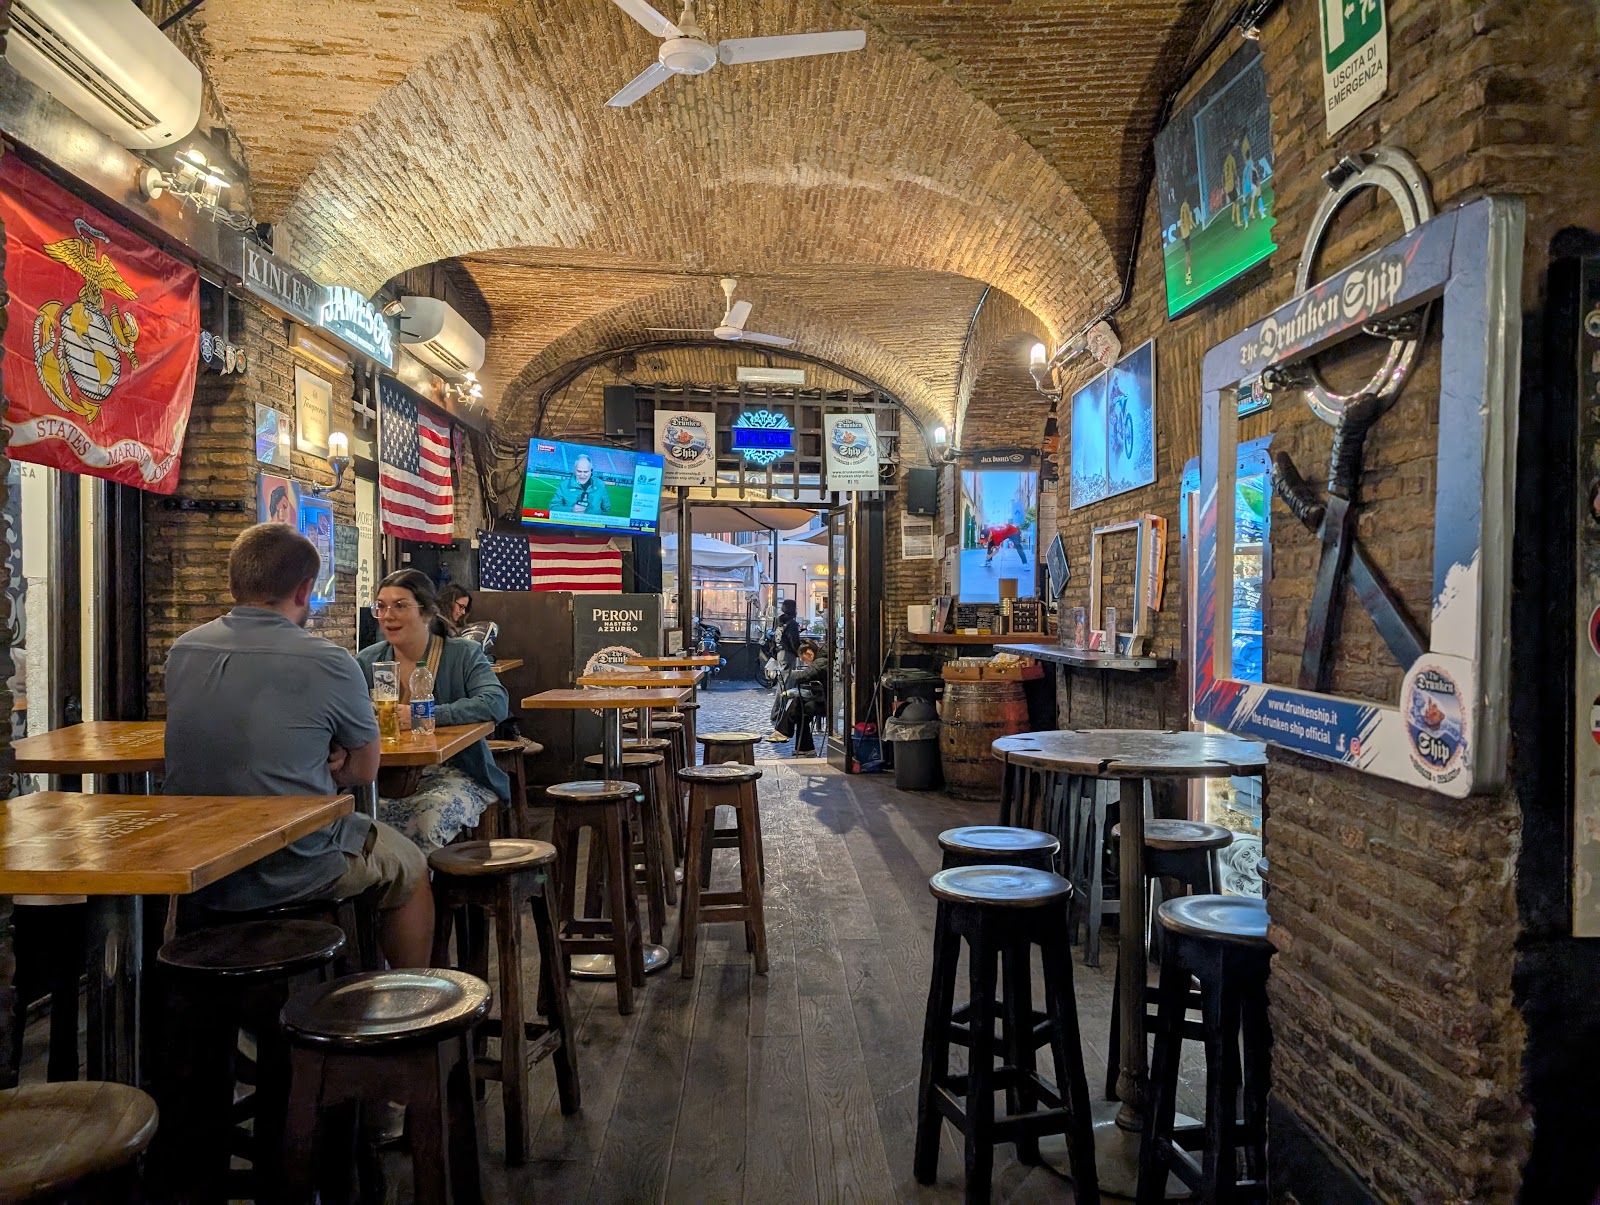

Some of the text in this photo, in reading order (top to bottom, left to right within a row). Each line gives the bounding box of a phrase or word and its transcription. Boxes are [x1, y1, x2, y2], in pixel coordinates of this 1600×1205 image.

[1332, 44, 1377, 89] USCITA DI
[1328, 59, 1384, 111] EMERGENZA
[247, 248, 312, 313] KINLEY
[325, 286, 392, 359] JAMESON
[1240, 258, 1404, 365] The Drunken Ship
[671, 418, 701, 427] Drunken
[37, 419, 91, 456] STATES
[106, 443, 150, 468] MARINE
[149, 454, 176, 482] ORP
[672, 446, 698, 460] Ship
[839, 446, 862, 458] Ship
[592, 608, 643, 621] PERONI
[598, 653, 628, 664] Drunk
[1417, 673, 1454, 693] Drunken
[1429, 671, 1440, 680] The
[1267, 699, 1338, 726] www.drunkenship.it
[1251, 711, 1331, 744] the drunken ship official
[1418, 732, 1450, 764] Ship
